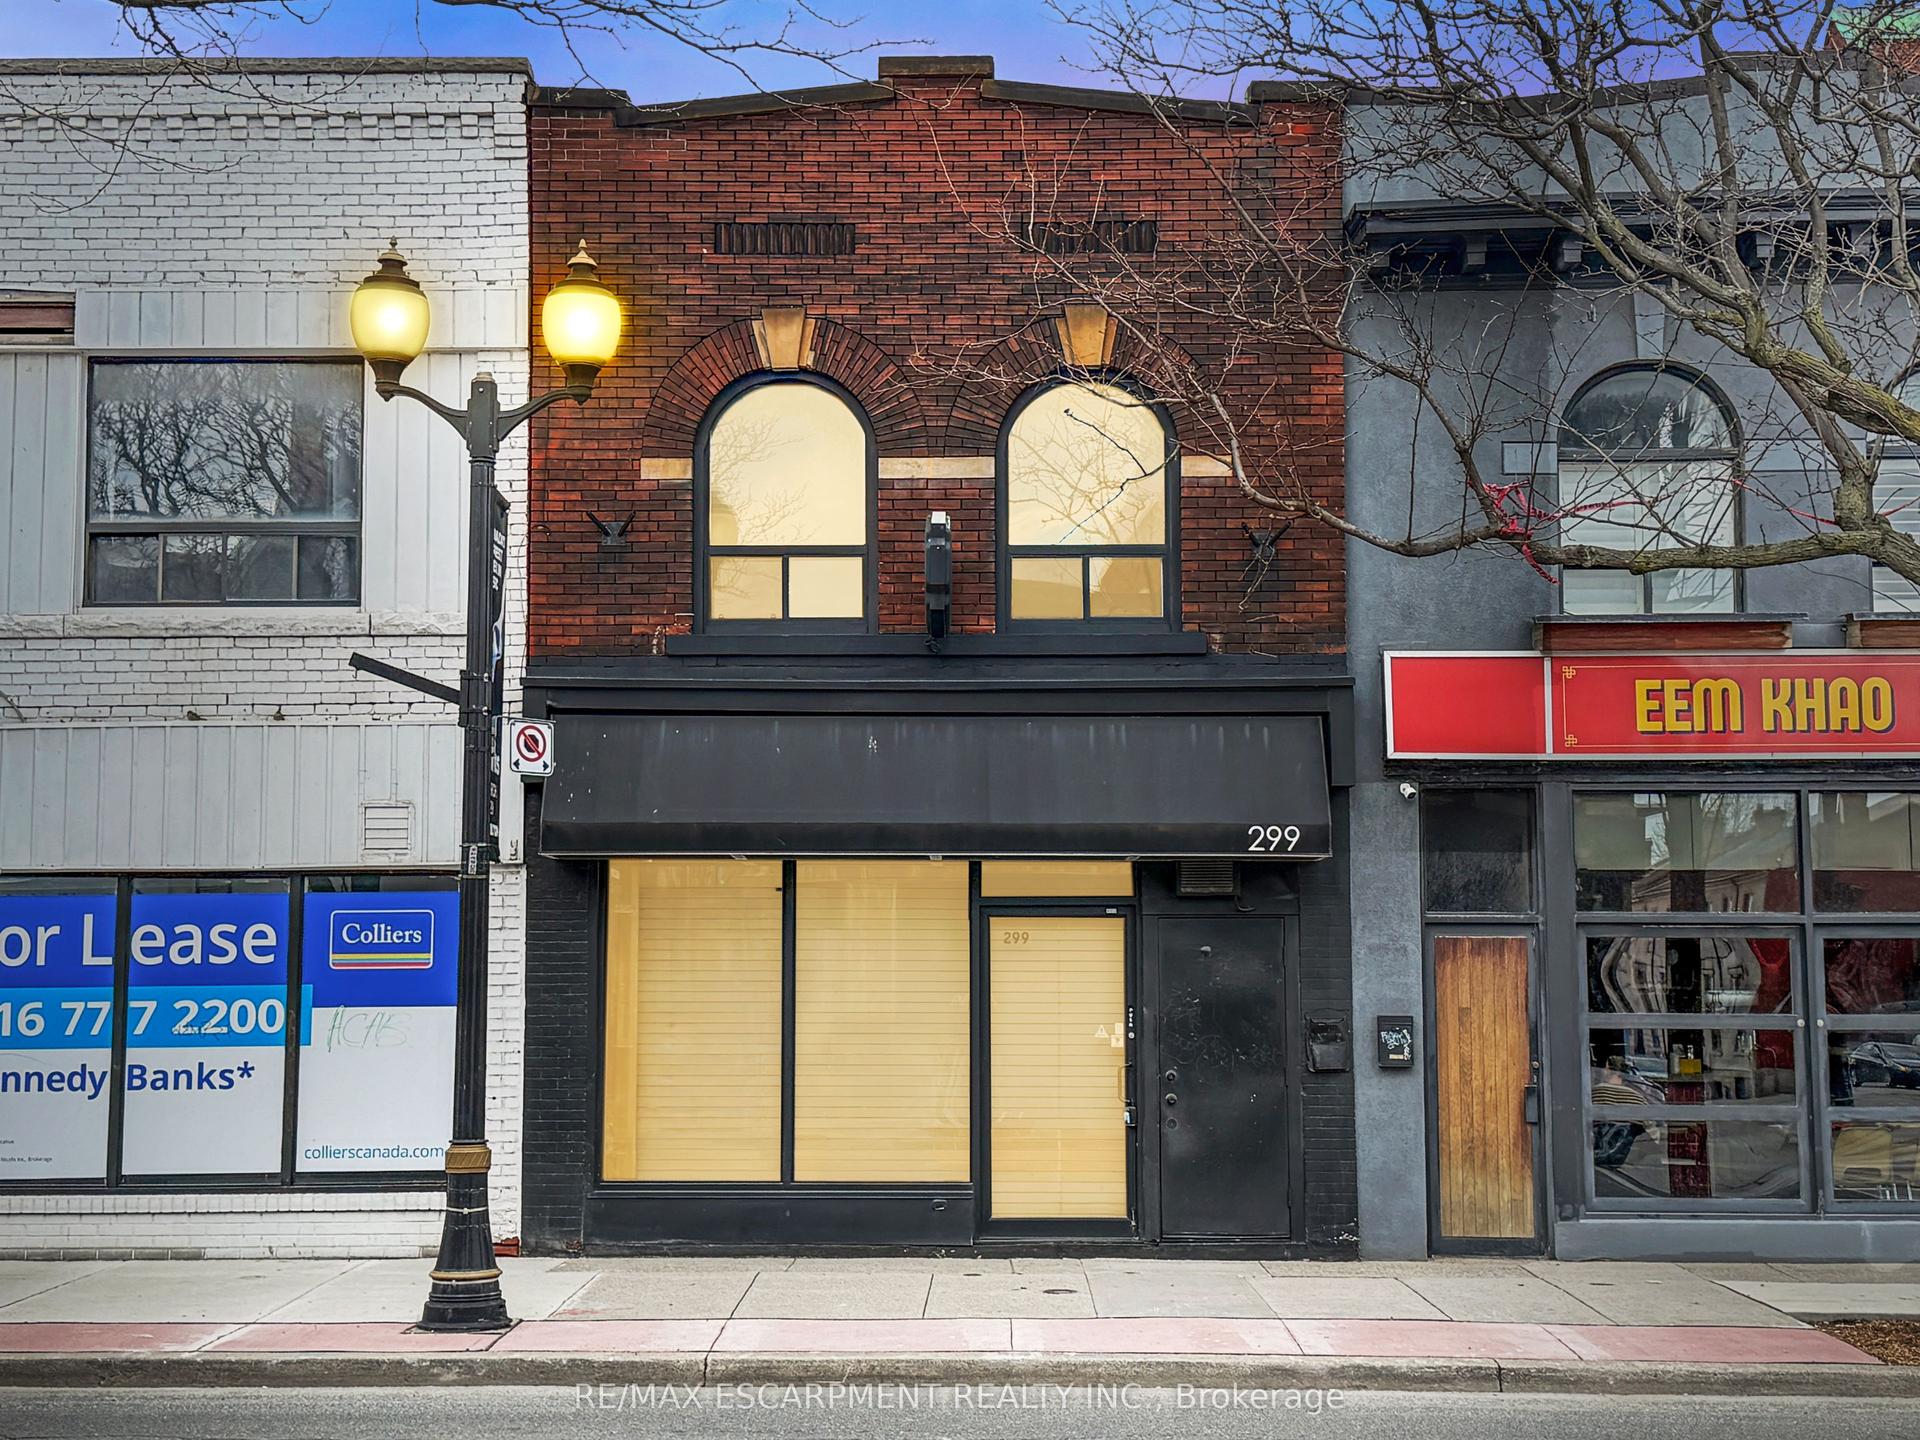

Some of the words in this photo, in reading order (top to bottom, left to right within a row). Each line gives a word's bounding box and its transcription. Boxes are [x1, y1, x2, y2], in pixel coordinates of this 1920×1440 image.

[1635, 678, 1744, 734] EEM
[1761, 676, 1895, 734] KHAO
[1247, 825, 1301, 852] 299
[0, 925, 61, 967] or
[82, 913, 277, 967] Lease
[342, 923, 422, 944] Colliers
[1003, 931, 1030, 944] 299
[0, 1001, 45, 1037] 16
[172, 998, 285, 1034] 2200
[0, 1063, 109, 1100] nnedy
[304, 1144, 445, 1159] collierscanada.com
